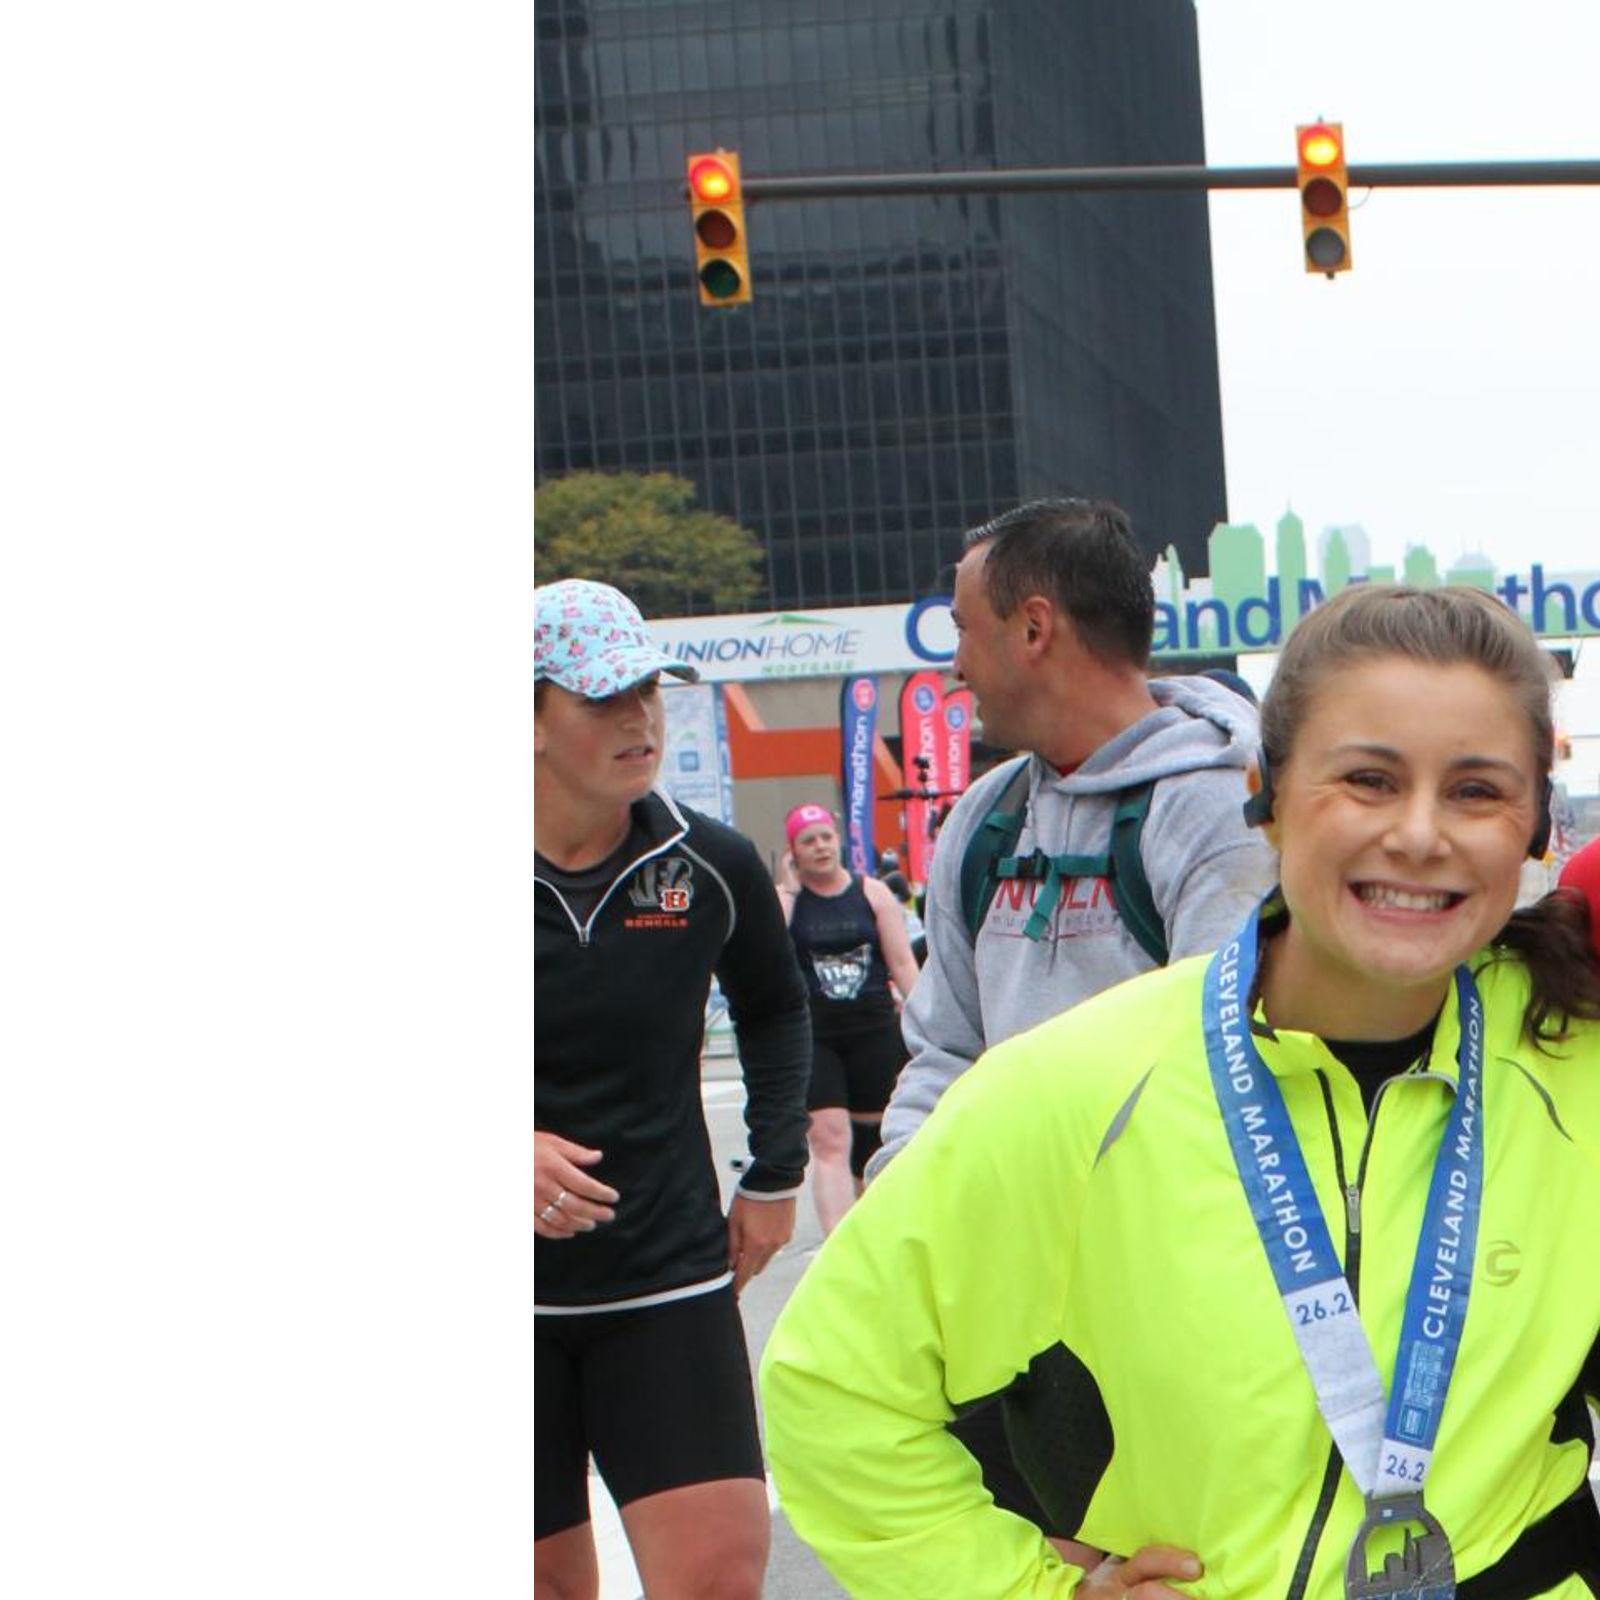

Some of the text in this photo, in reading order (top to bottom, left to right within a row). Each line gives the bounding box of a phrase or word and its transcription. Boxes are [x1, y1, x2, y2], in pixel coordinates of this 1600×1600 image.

[1217, 941, 1316, 1273] CLEVELAND MARATHON
[1422, 1169, 1469, 1339] CLEVELAND
[1455, 998, 1480, 1161] MARATHON
[1296, 1293, 1351, 1326] 26.2
[1385, 1454, 1426, 1483] 26.2
